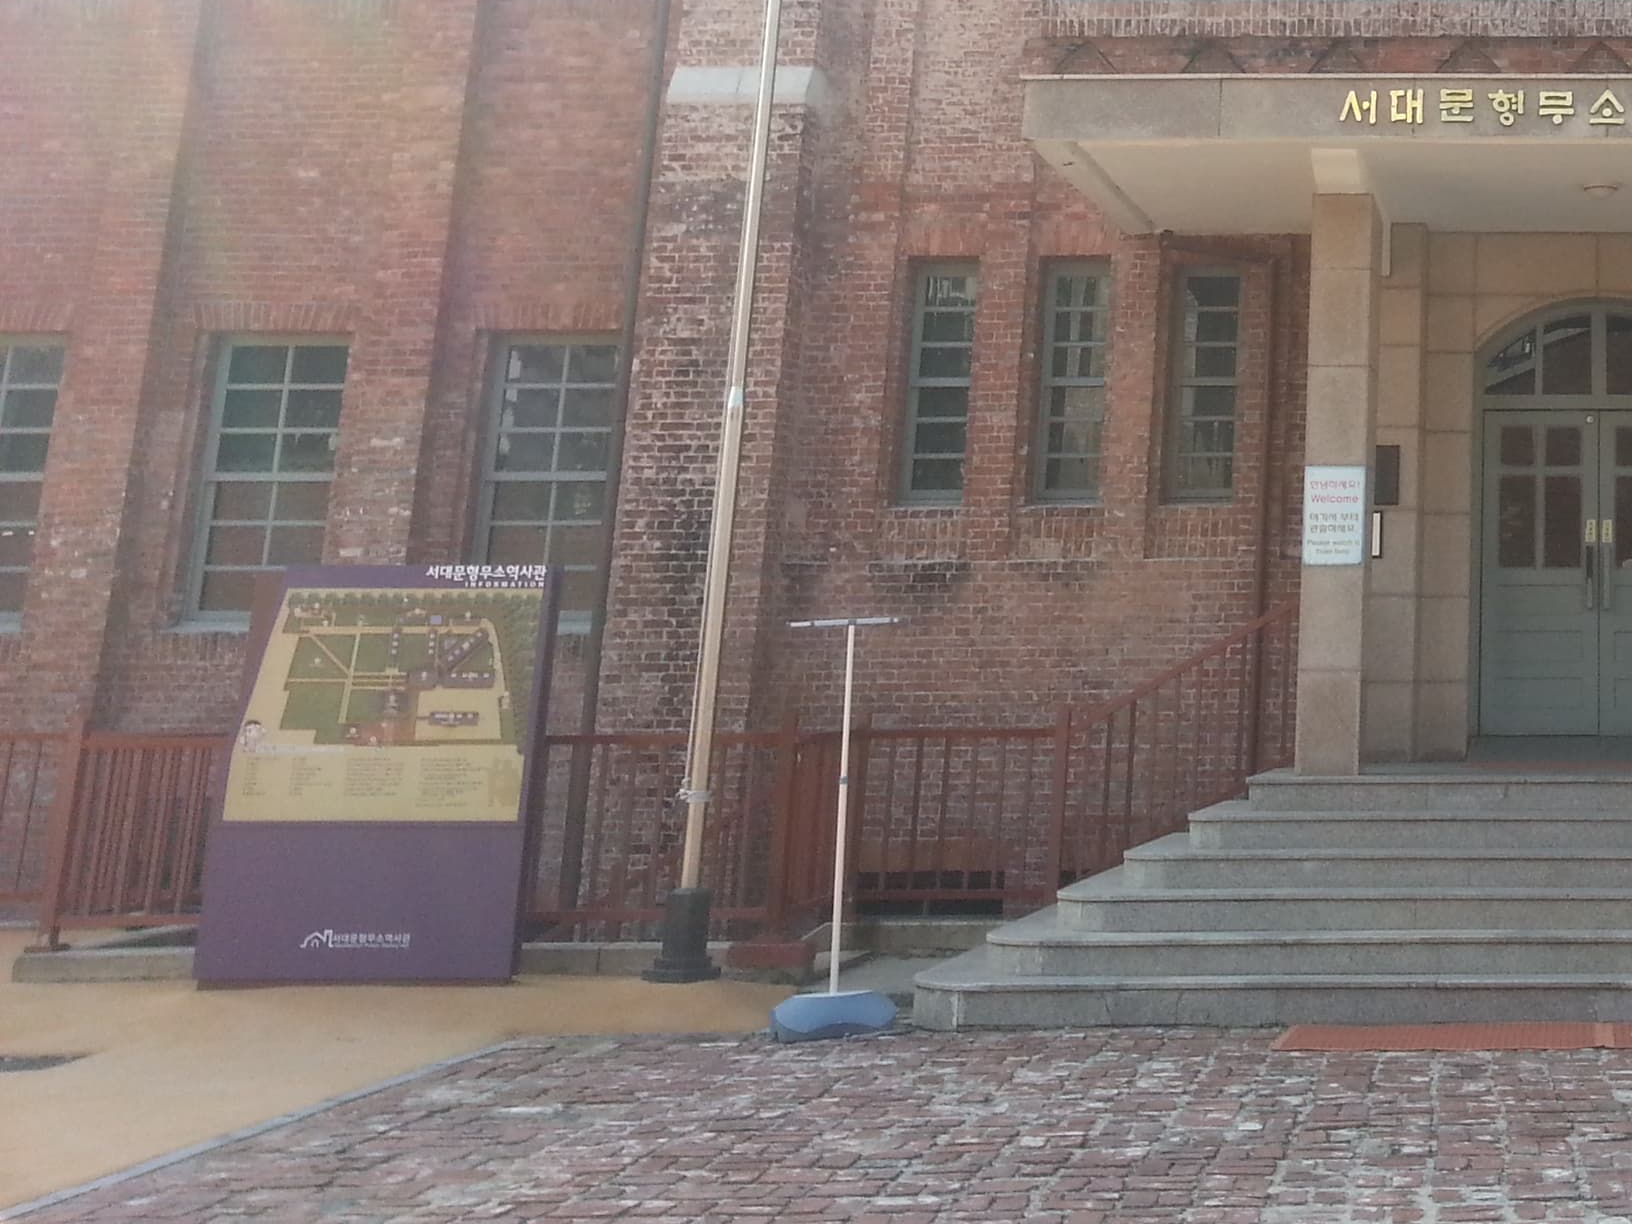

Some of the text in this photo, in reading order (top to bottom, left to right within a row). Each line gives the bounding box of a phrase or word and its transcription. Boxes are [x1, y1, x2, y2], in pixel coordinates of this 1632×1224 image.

[1311, 494, 1359, 504] Welcome
[425, 564, 548, 582] 서대문형무소역사관
[464, 581, 545, 589] INFORMATION
